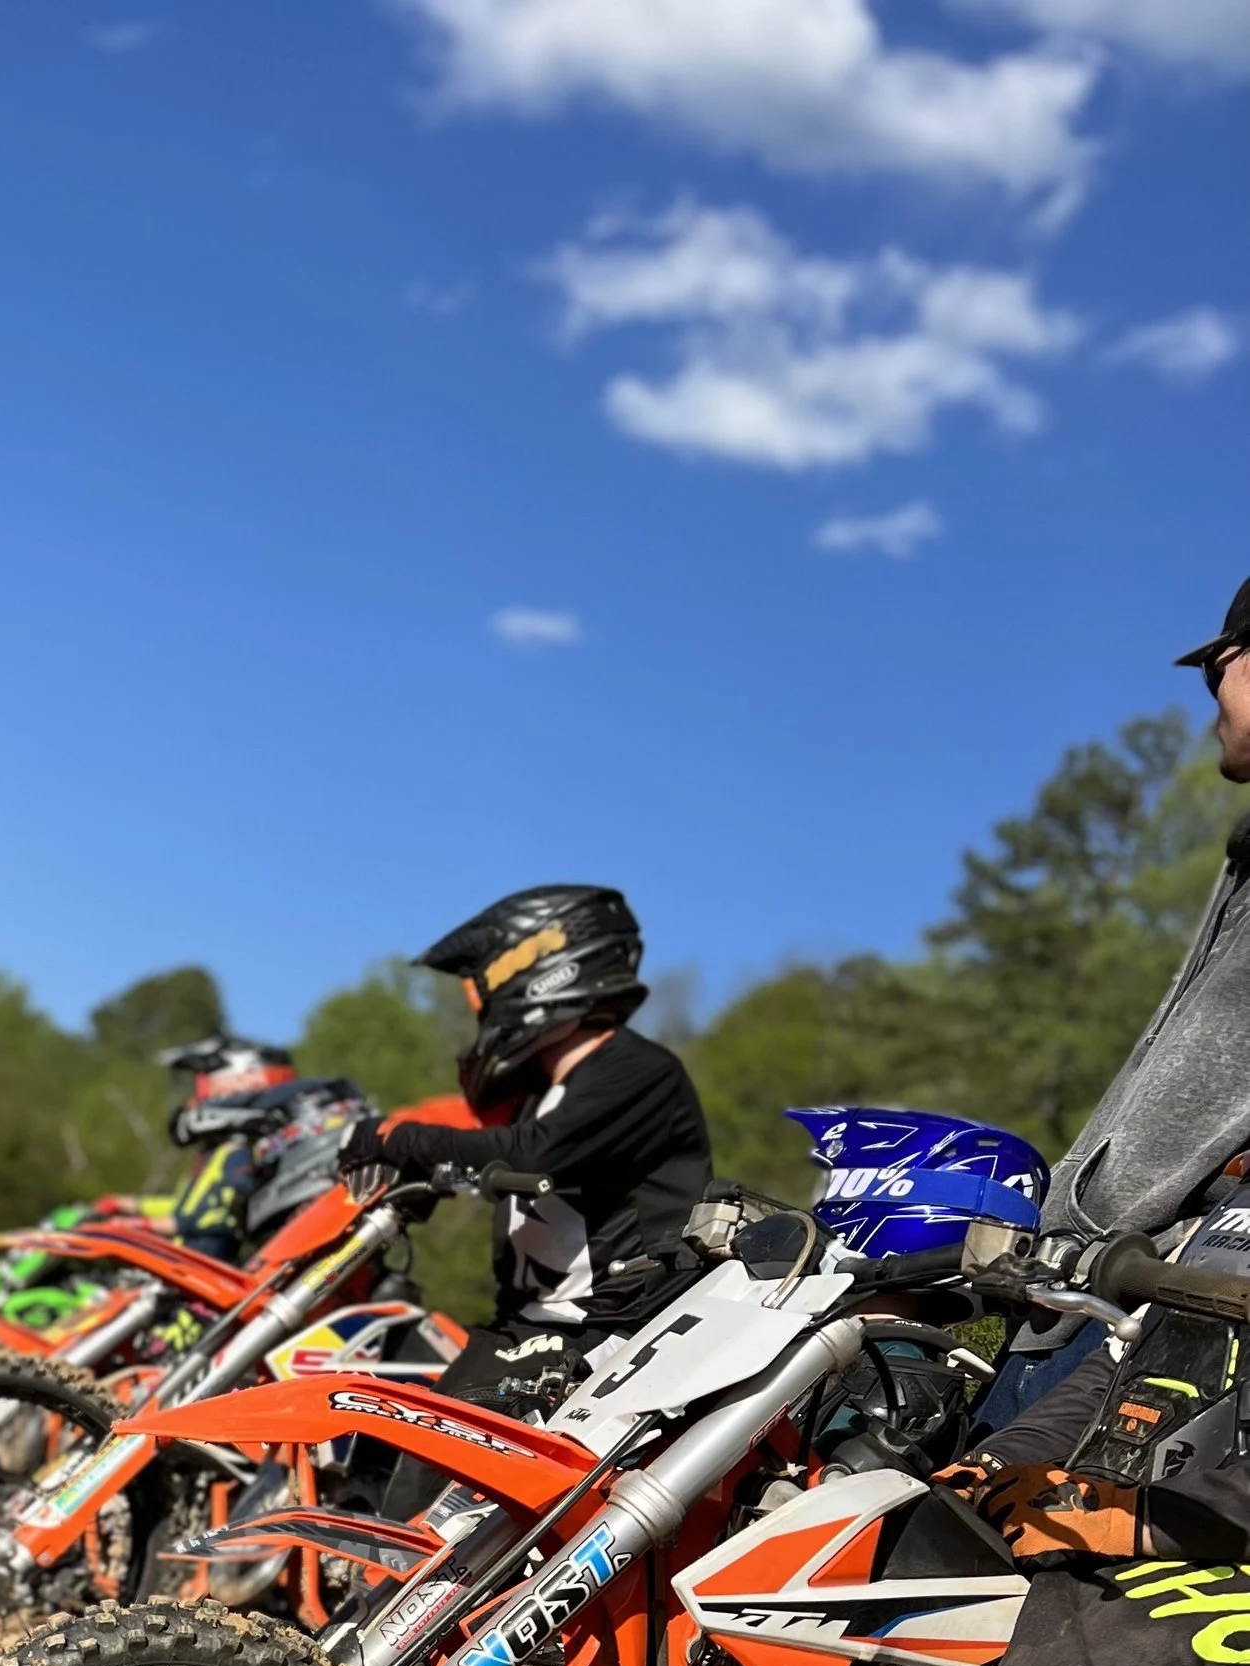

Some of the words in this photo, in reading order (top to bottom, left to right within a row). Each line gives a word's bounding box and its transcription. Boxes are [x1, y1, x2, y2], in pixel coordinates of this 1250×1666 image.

[825, 1168, 914, 1198] 00%
[494, 1333, 563, 1363] KTM
[591, 1313, 703, 1400] 5
[564, 1407, 593, 1423] KTM
[710, 1607, 851, 1641] KTM
